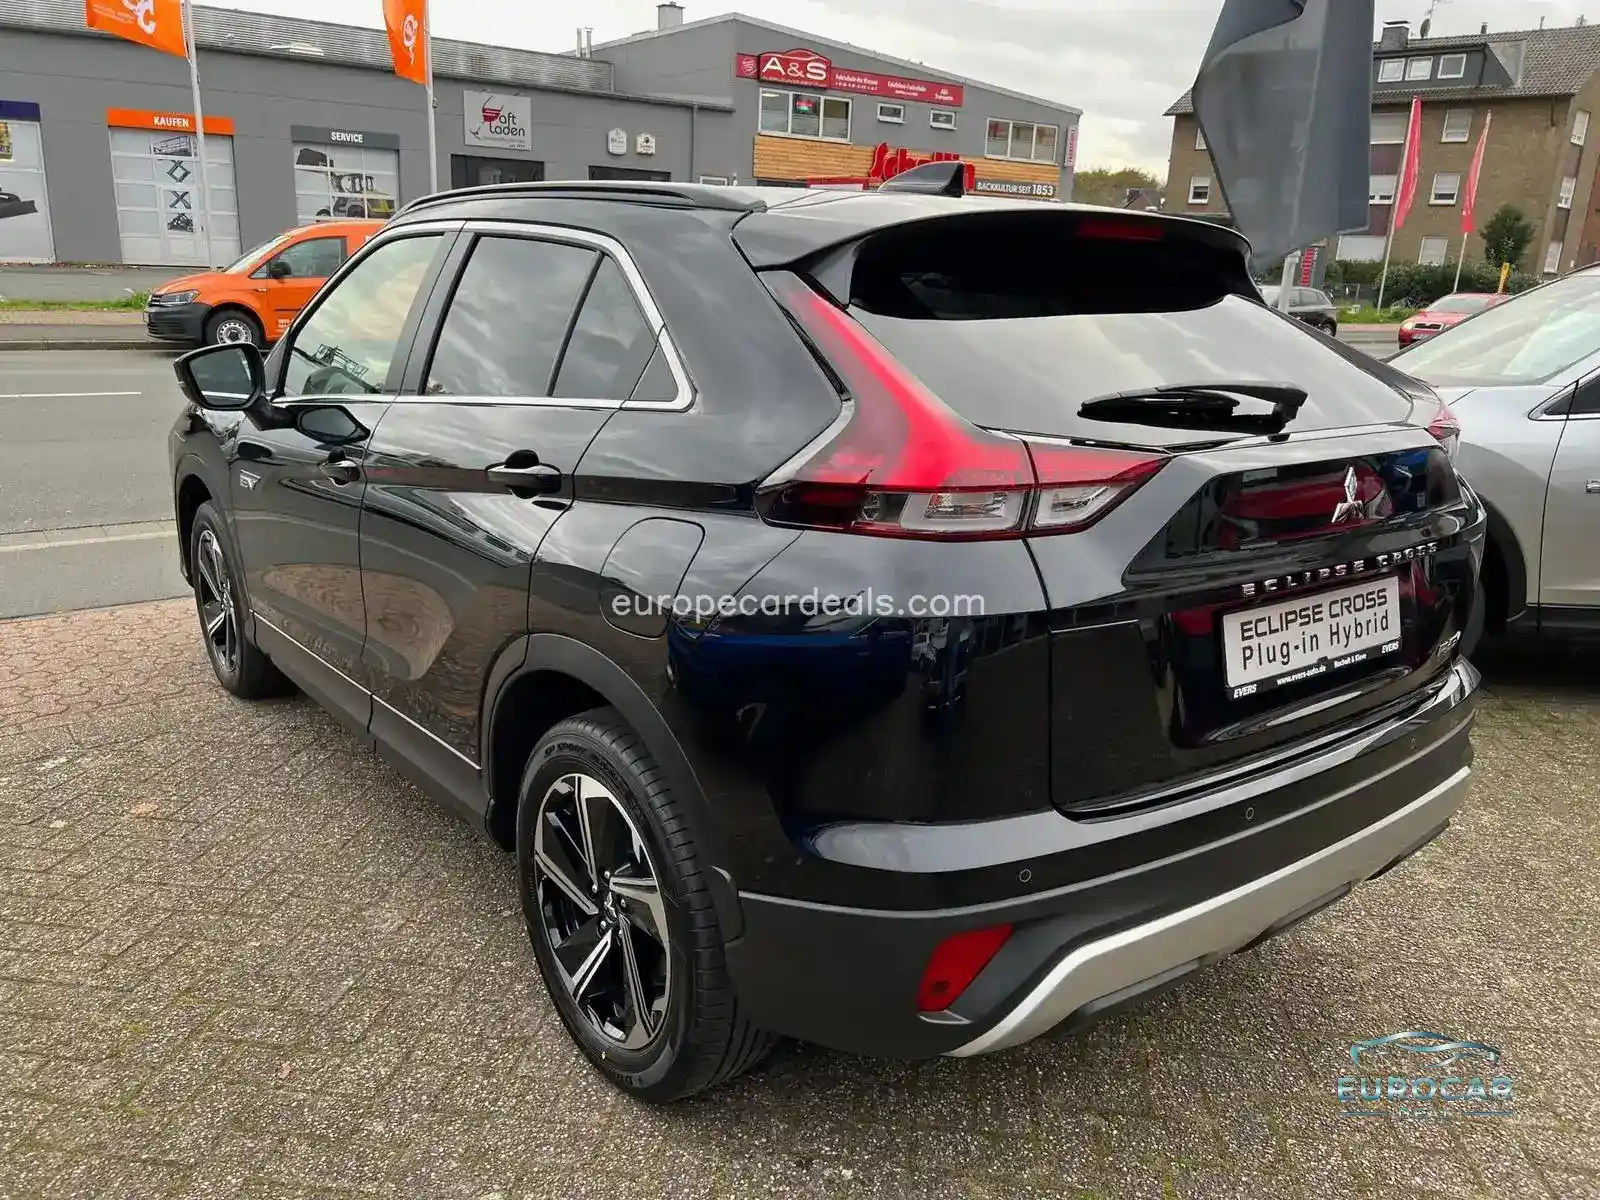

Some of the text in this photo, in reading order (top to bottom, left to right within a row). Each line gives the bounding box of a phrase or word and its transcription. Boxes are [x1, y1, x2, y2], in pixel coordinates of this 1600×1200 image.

[762, 57, 827, 81] A&S
[153, 116, 189, 128] KAUFEN
[331, 131, 363, 143] SERVICE
[977, 181, 1054, 196] BACKKULTUR SEIT 1853
[1241, 541, 1439, 597] ECLIPSE CROSS
[1240, 588, 1388, 642] ECLIPSE CROSS
[1241, 631, 1319, 670] Plug-in
[1329, 609, 1389, 649] Hybrid
[1381, 641, 1400, 654] EVERS
[1276, 664, 1327, 686] www.evers-auto.de
[1233, 683, 1258, 699] EVERS
